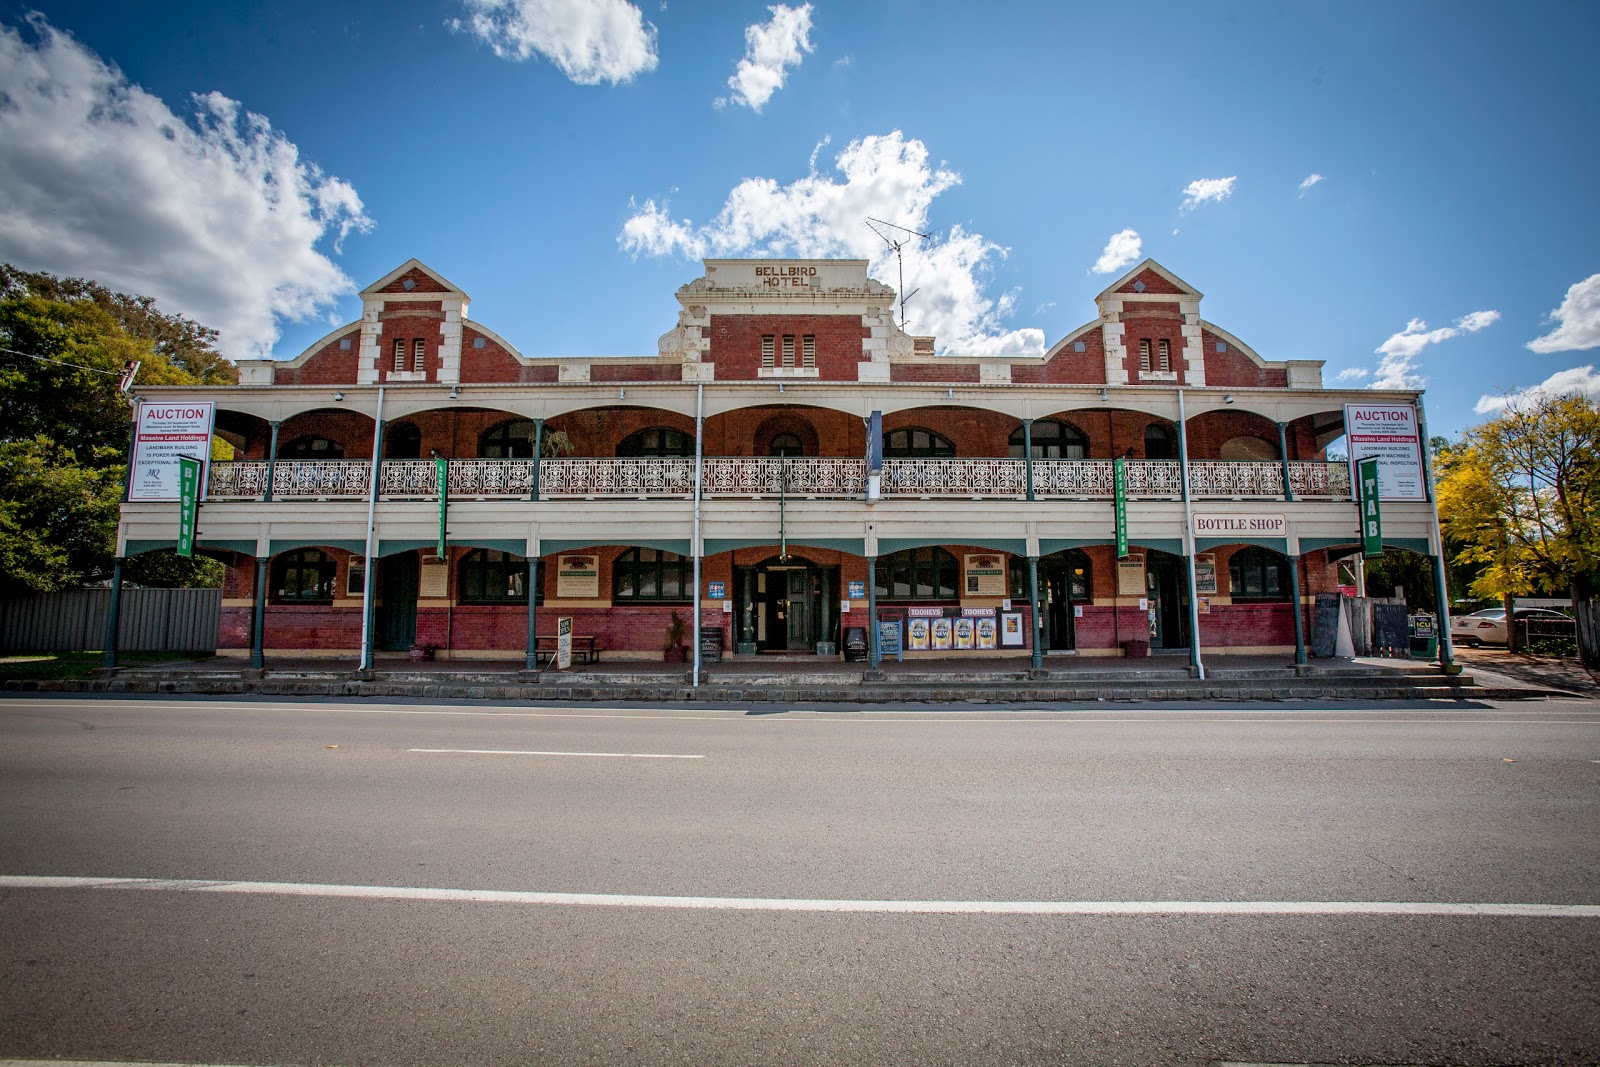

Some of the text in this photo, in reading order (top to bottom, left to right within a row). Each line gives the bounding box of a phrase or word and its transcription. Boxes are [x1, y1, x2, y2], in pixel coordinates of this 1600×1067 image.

[755, 266, 817, 276] BELLBIRD
[764, 276, 808, 286] HOTEL
[146, 409, 204, 419] AUCTION
[1355, 411, 1408, 421] AUCTION
[182, 467, 192, 549] BISTRO
[1365, 478, 1378, 536] TAB
[1197, 519, 1283, 530] BOTTLE SHOP
